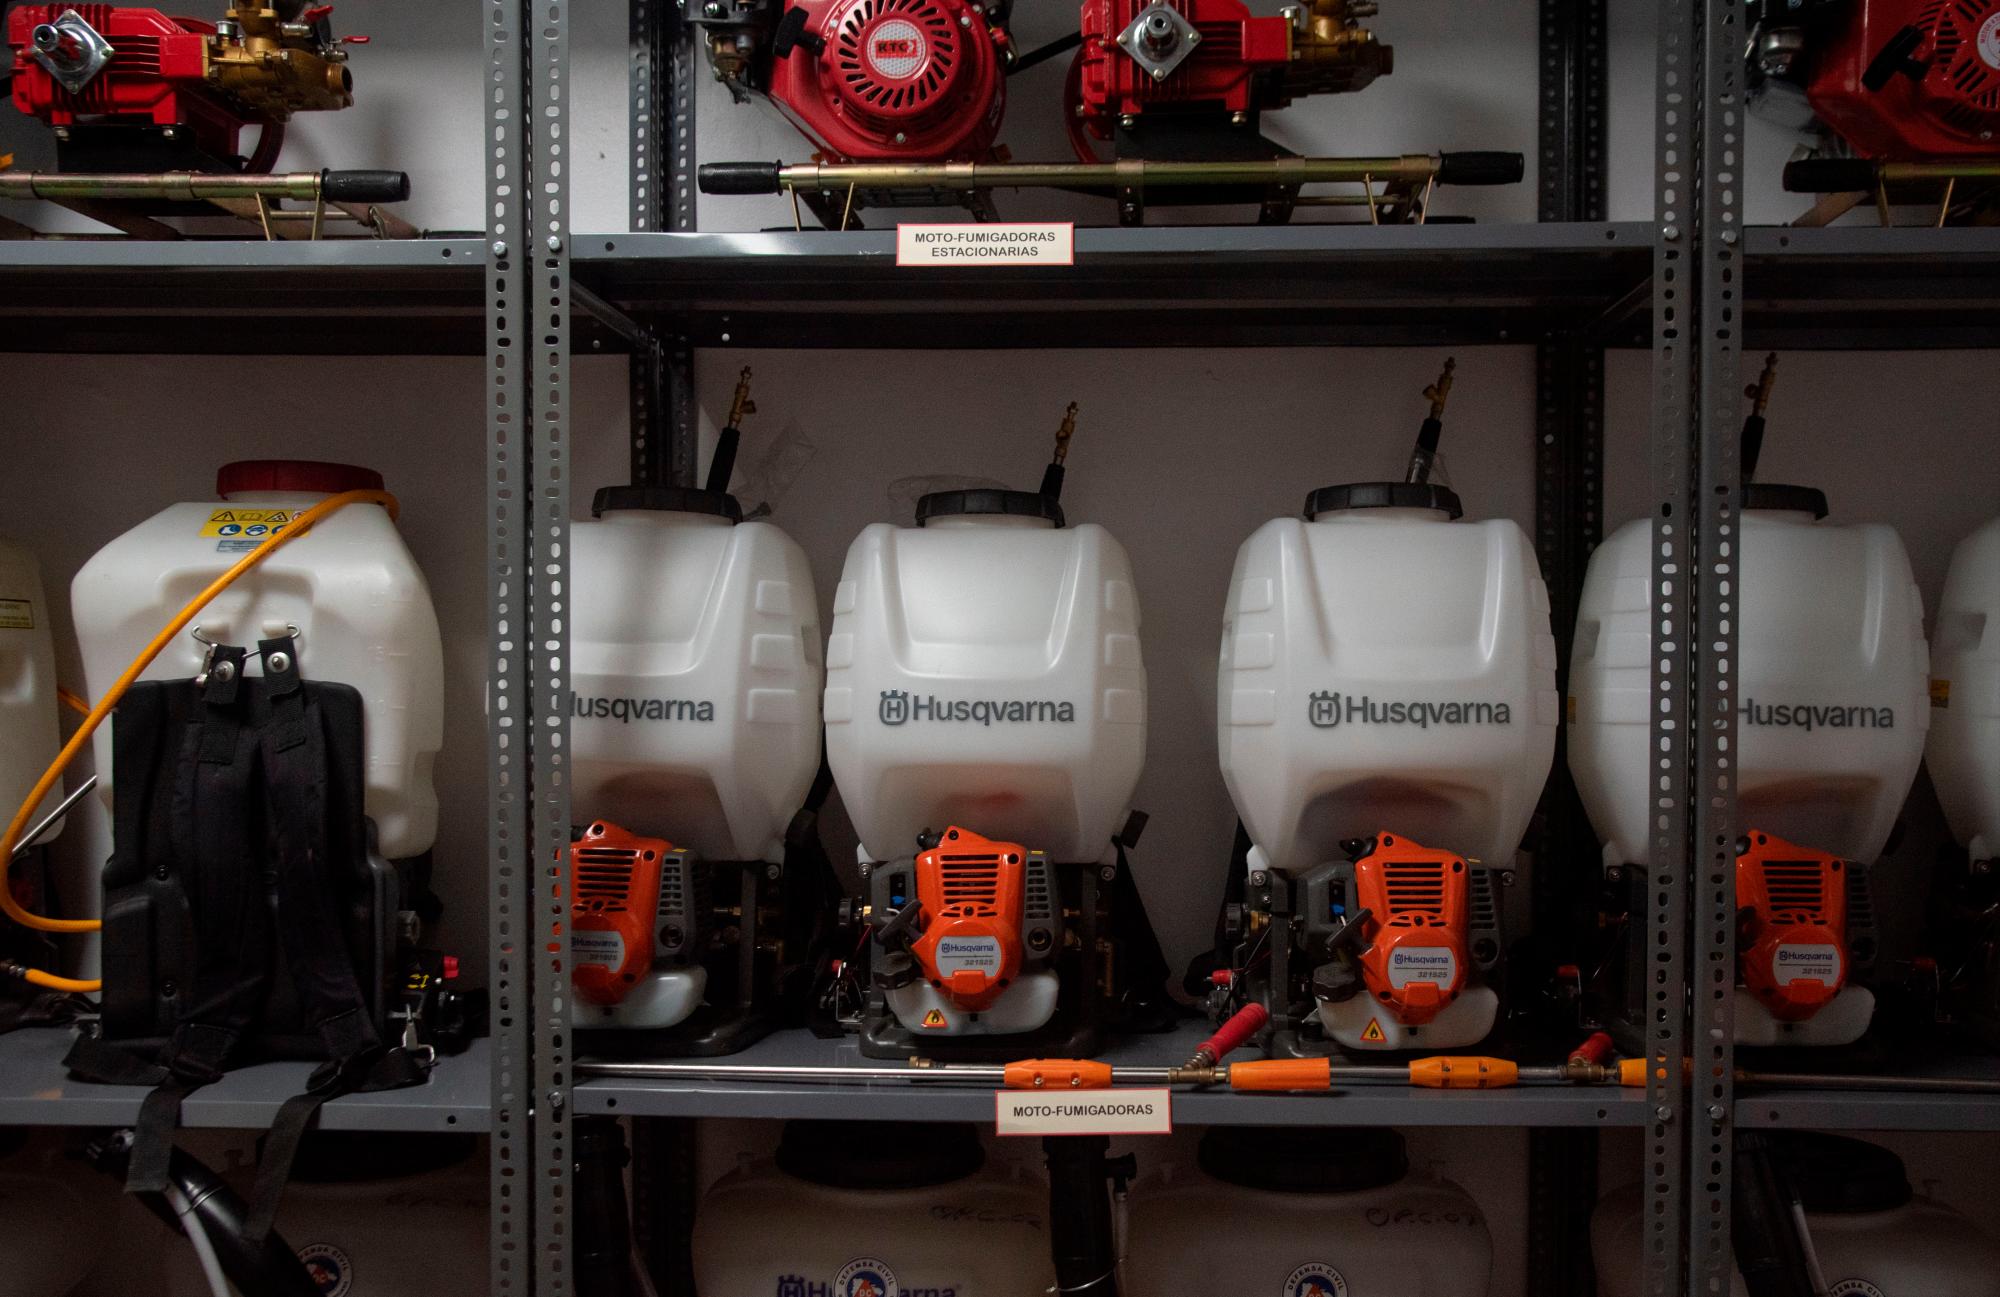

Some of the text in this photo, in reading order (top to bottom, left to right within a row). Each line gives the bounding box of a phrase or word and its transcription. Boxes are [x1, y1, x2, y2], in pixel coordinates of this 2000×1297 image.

[915, 232, 1056, 243] MOTO-FUMIGADORAS
[931, 246, 1039, 257] ESTACIONARIAS
[570, 690, 714, 723] usqvarna
[913, 695, 1075, 726] Husqvarna
[1346, 695, 1510, 728] Husqvarna
[950, 943, 993, 952] Husqvarna
[1404, 955, 1448, 964] Husqvarna
[1788, 951, 1833, 961] Husqvarna
[1013, 1104, 1153, 1117] MOTO-FUMIGADORAS
[839, 1262, 895, 1286] DEFENSA CIVIL
[1288, 1265, 1344, 1290] DEFENSA CIVIL
